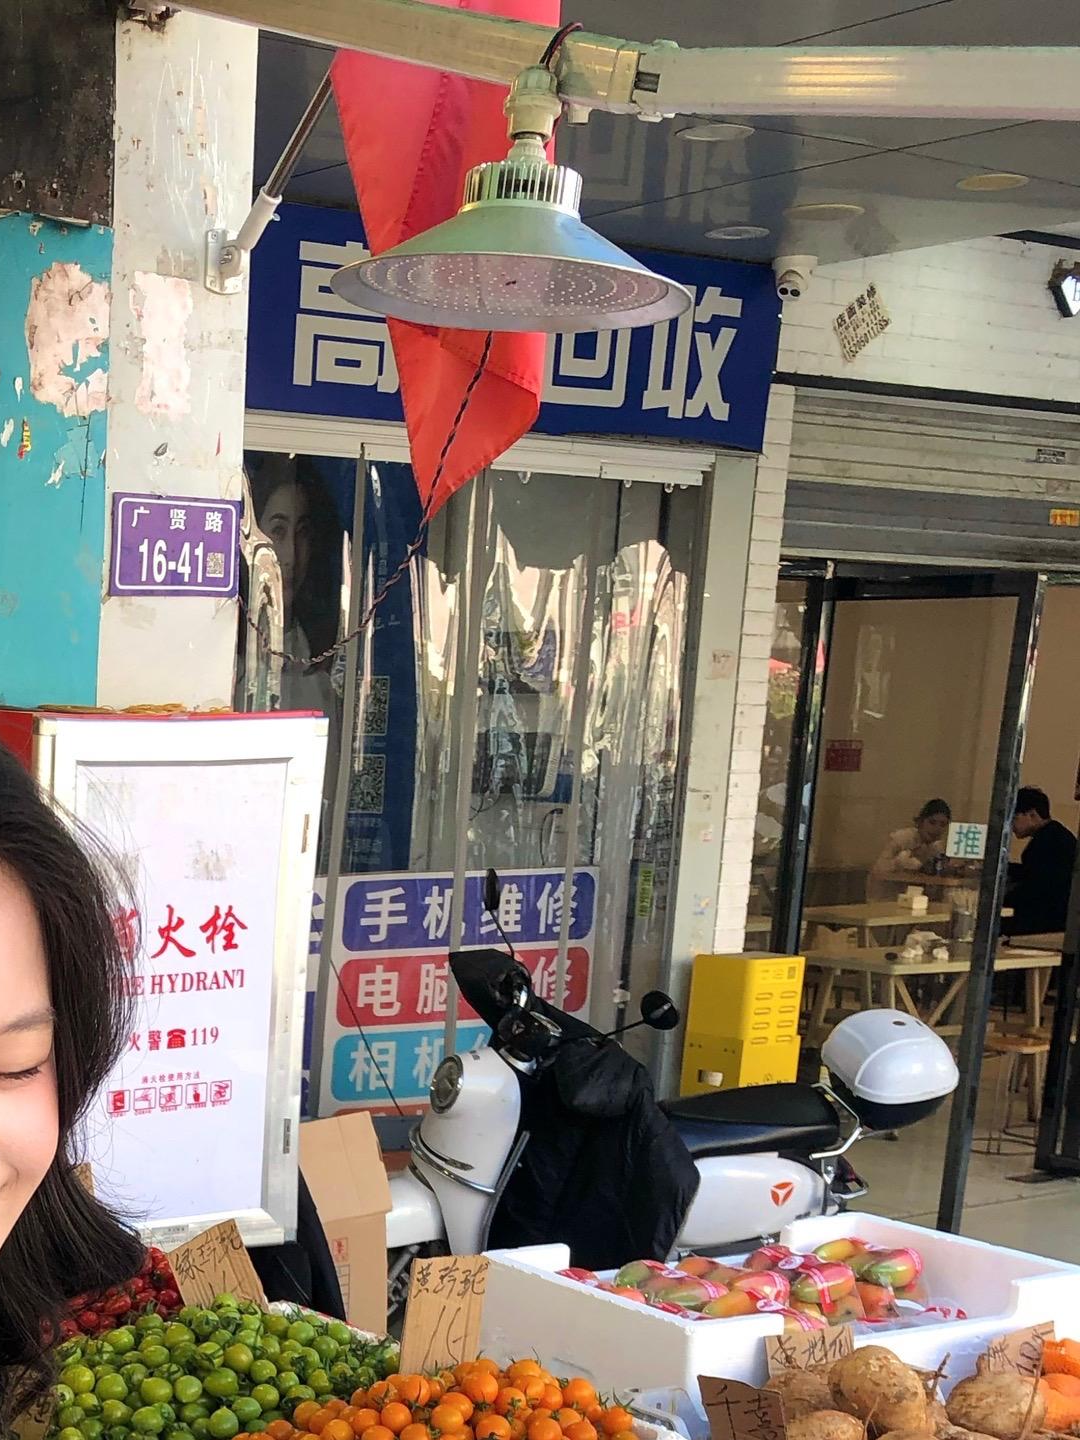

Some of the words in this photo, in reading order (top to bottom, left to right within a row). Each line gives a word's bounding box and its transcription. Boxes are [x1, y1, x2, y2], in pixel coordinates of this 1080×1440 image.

[292, 240, 743, 422] 高回收
[131, 505, 224, 533] 广贤路
[138, 538, 204, 583] 16-41
[953, 824, 982, 857] 推
[359, 880, 578, 943] 手机维修
[356, 956, 572, 1018] 电脑修
[191, 1026, 219, 1047] 119
